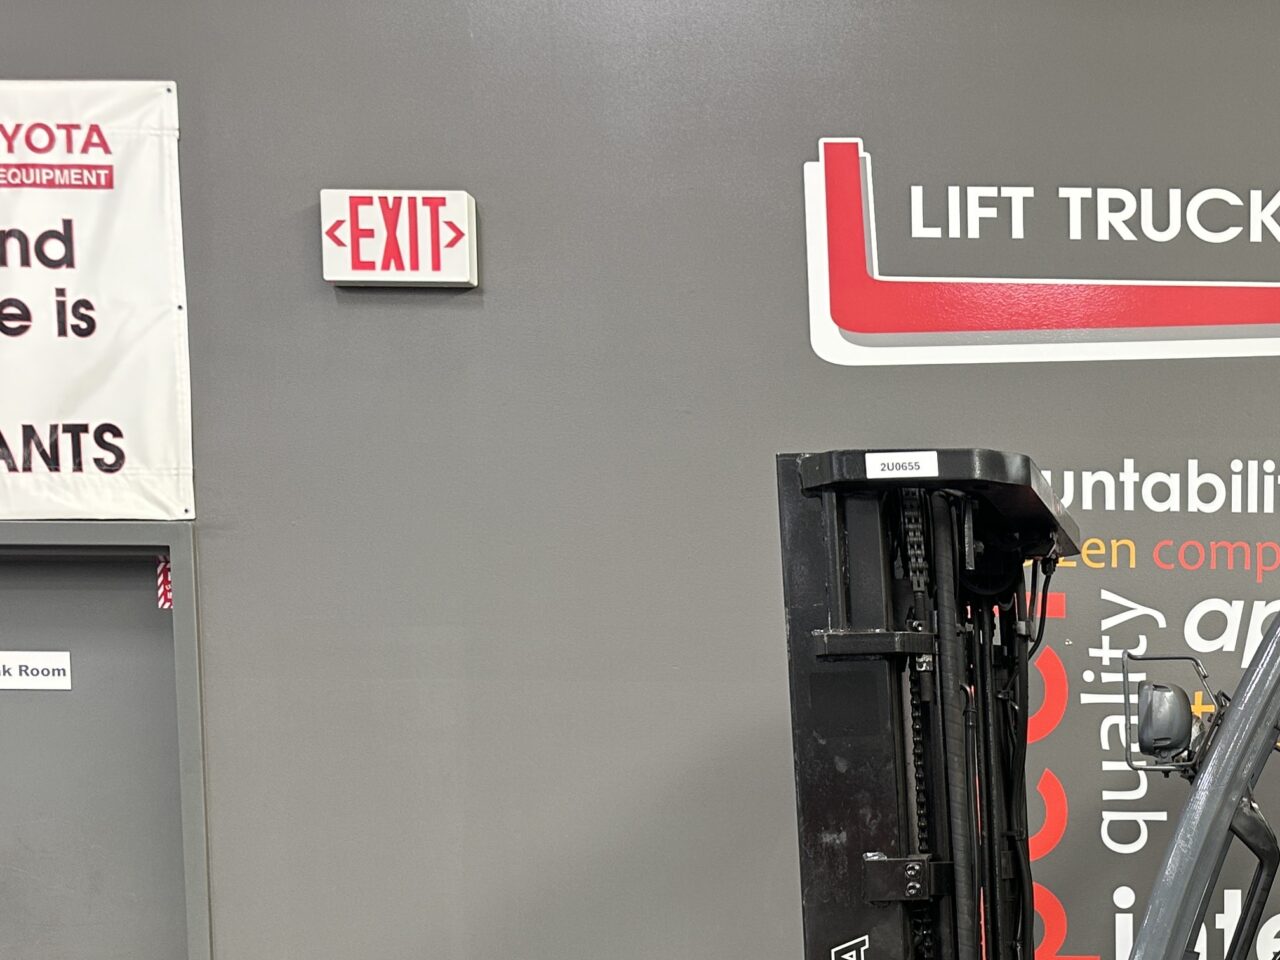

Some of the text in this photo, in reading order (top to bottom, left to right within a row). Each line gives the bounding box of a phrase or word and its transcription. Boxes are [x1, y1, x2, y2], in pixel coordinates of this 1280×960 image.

[0, 122, 112, 155] YOTA
[0, 168, 109, 185] EQUIPMENT
[909, 184, 1035, 239] LIFT
[348, 195, 447, 272] EXIT
[54, 287, 97, 338] is
[880, 462, 921, 472] 2U0655
[18, 664, 67, 677] Room
[1079, 588, 1168, 855] quality
